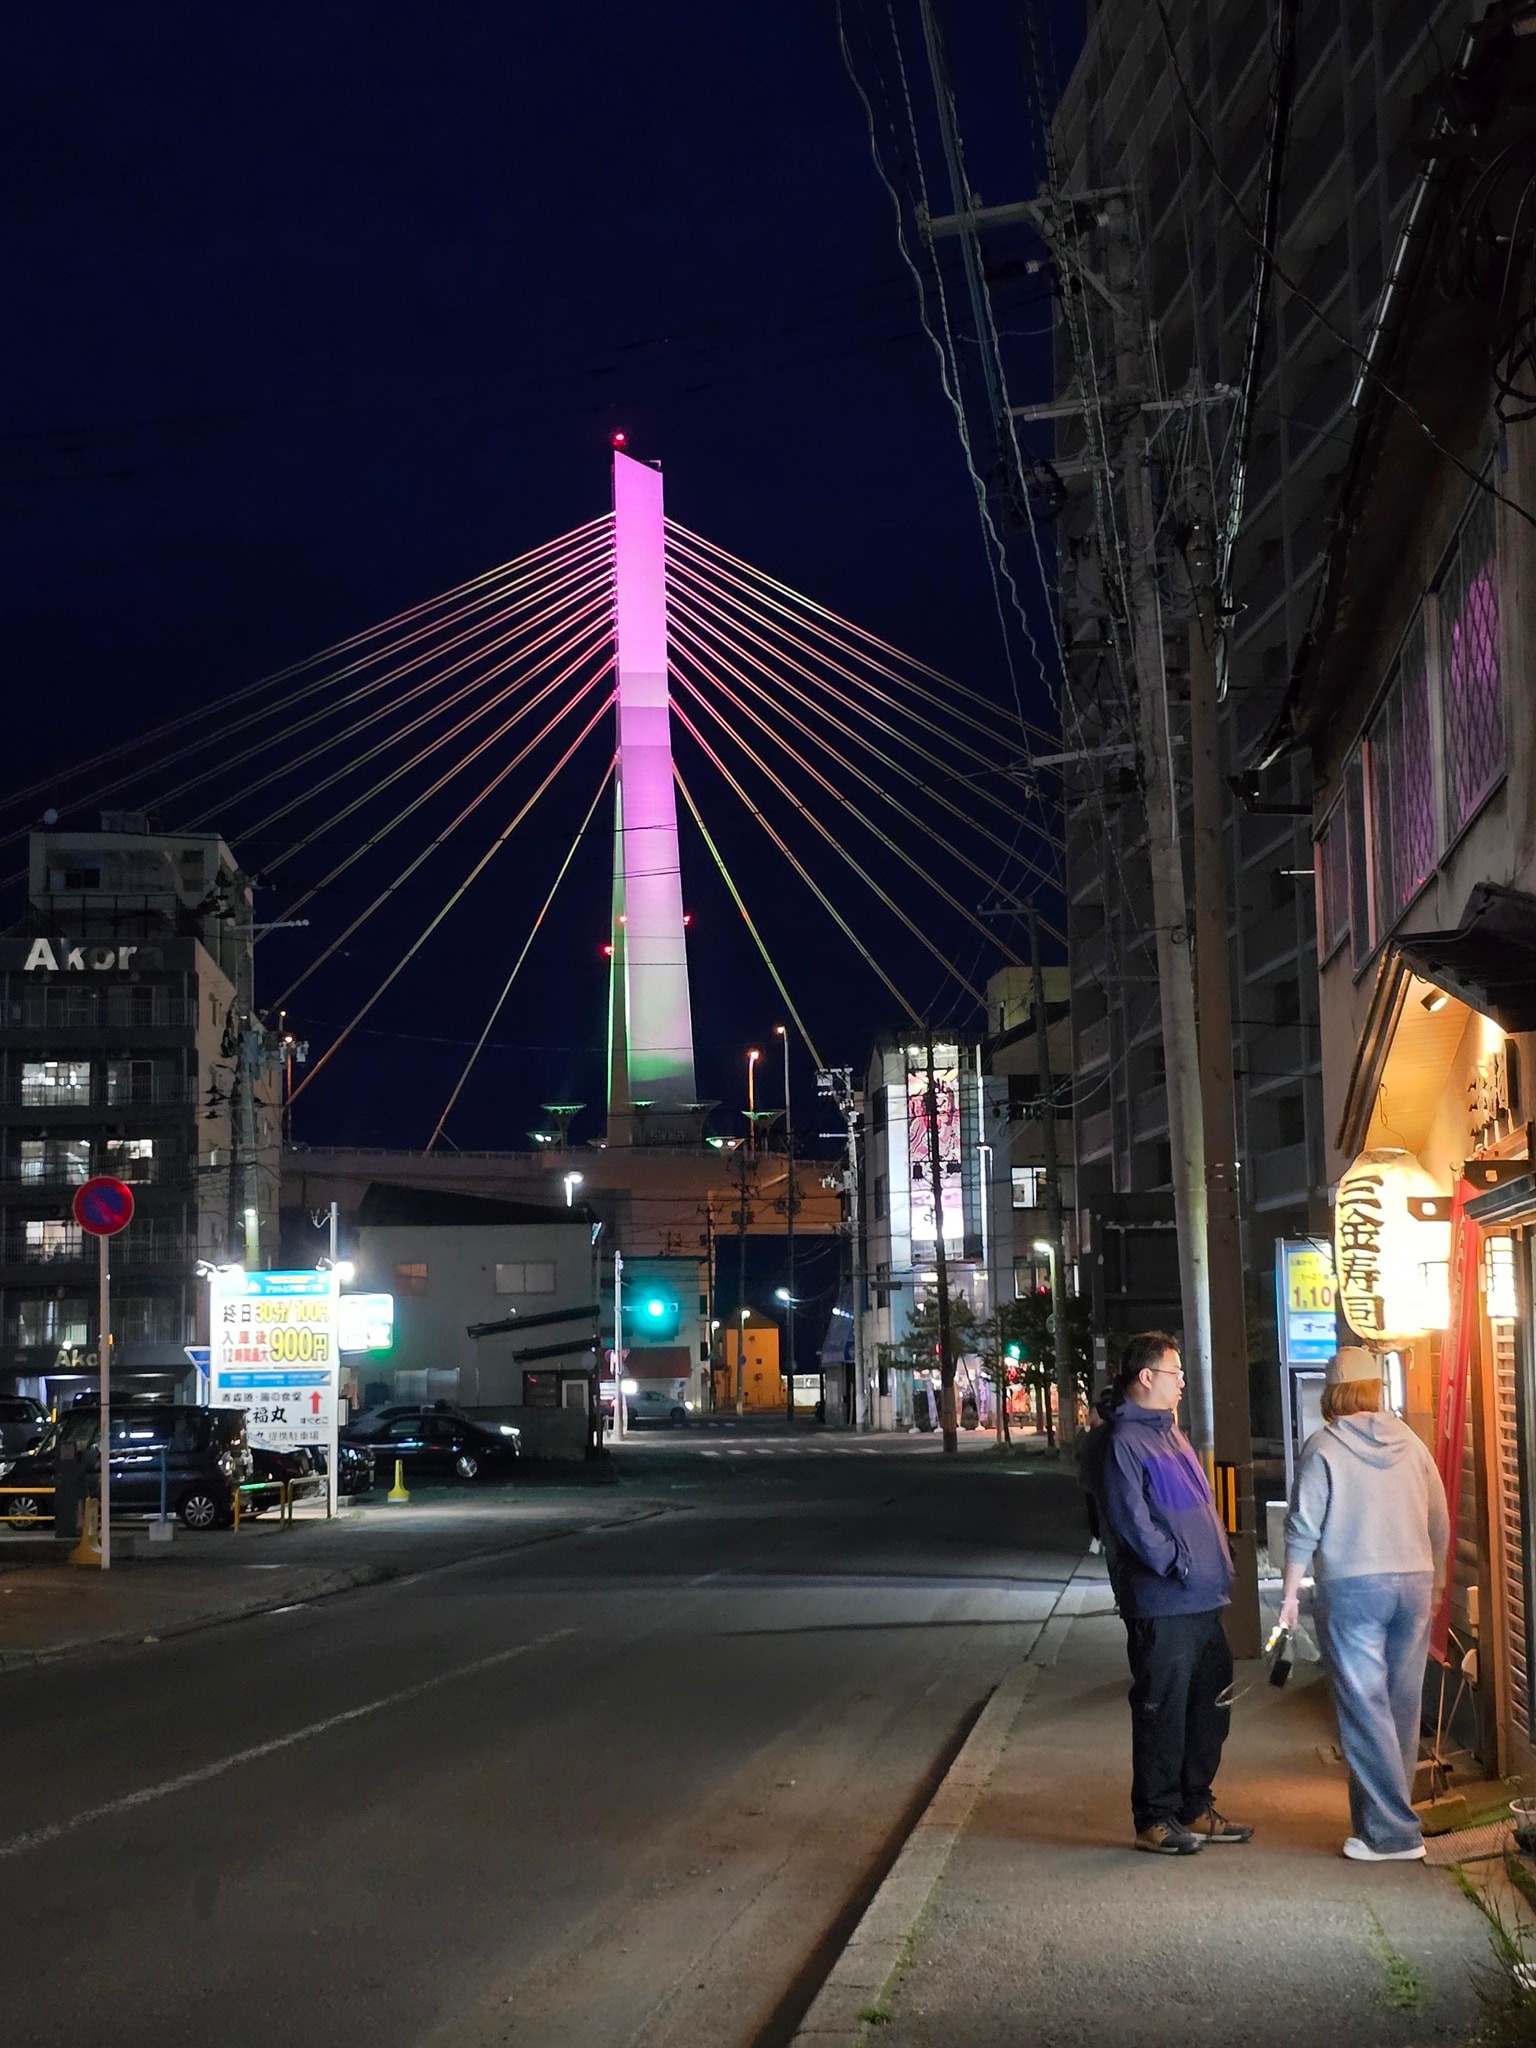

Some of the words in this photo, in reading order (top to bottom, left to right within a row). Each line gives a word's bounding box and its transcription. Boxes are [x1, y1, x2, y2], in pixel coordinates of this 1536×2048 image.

[1338, 1174, 1386, 1331] 三金寿司
[1293, 1286, 1336, 1309] 1,10
[269, 1326, 329, 1362] 900円
[246, 1405, 288, 1424] 福丸
